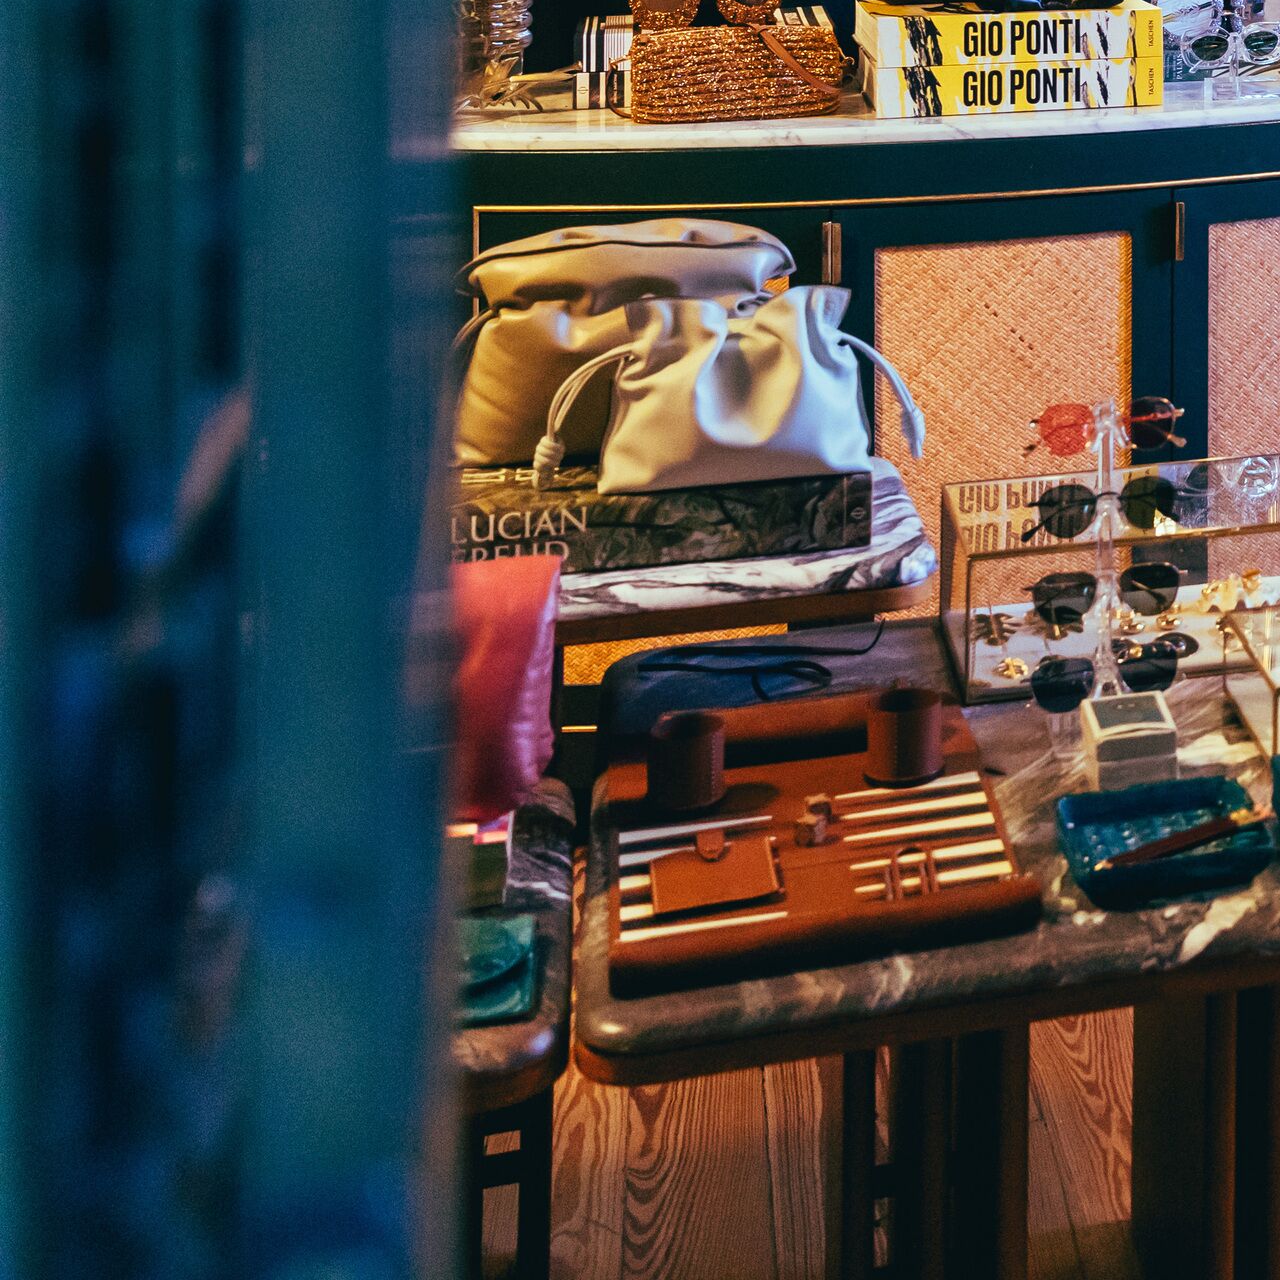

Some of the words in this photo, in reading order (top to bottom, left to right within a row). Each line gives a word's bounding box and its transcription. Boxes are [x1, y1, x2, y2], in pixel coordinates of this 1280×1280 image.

[963, 21, 1003, 58] GIO
[1010, 19, 1081, 55] PONTI
[963, 69, 1003, 107] GIO
[1010, 67, 1081, 104] PONTI
[451, 506, 588, 545] LUCIAN
